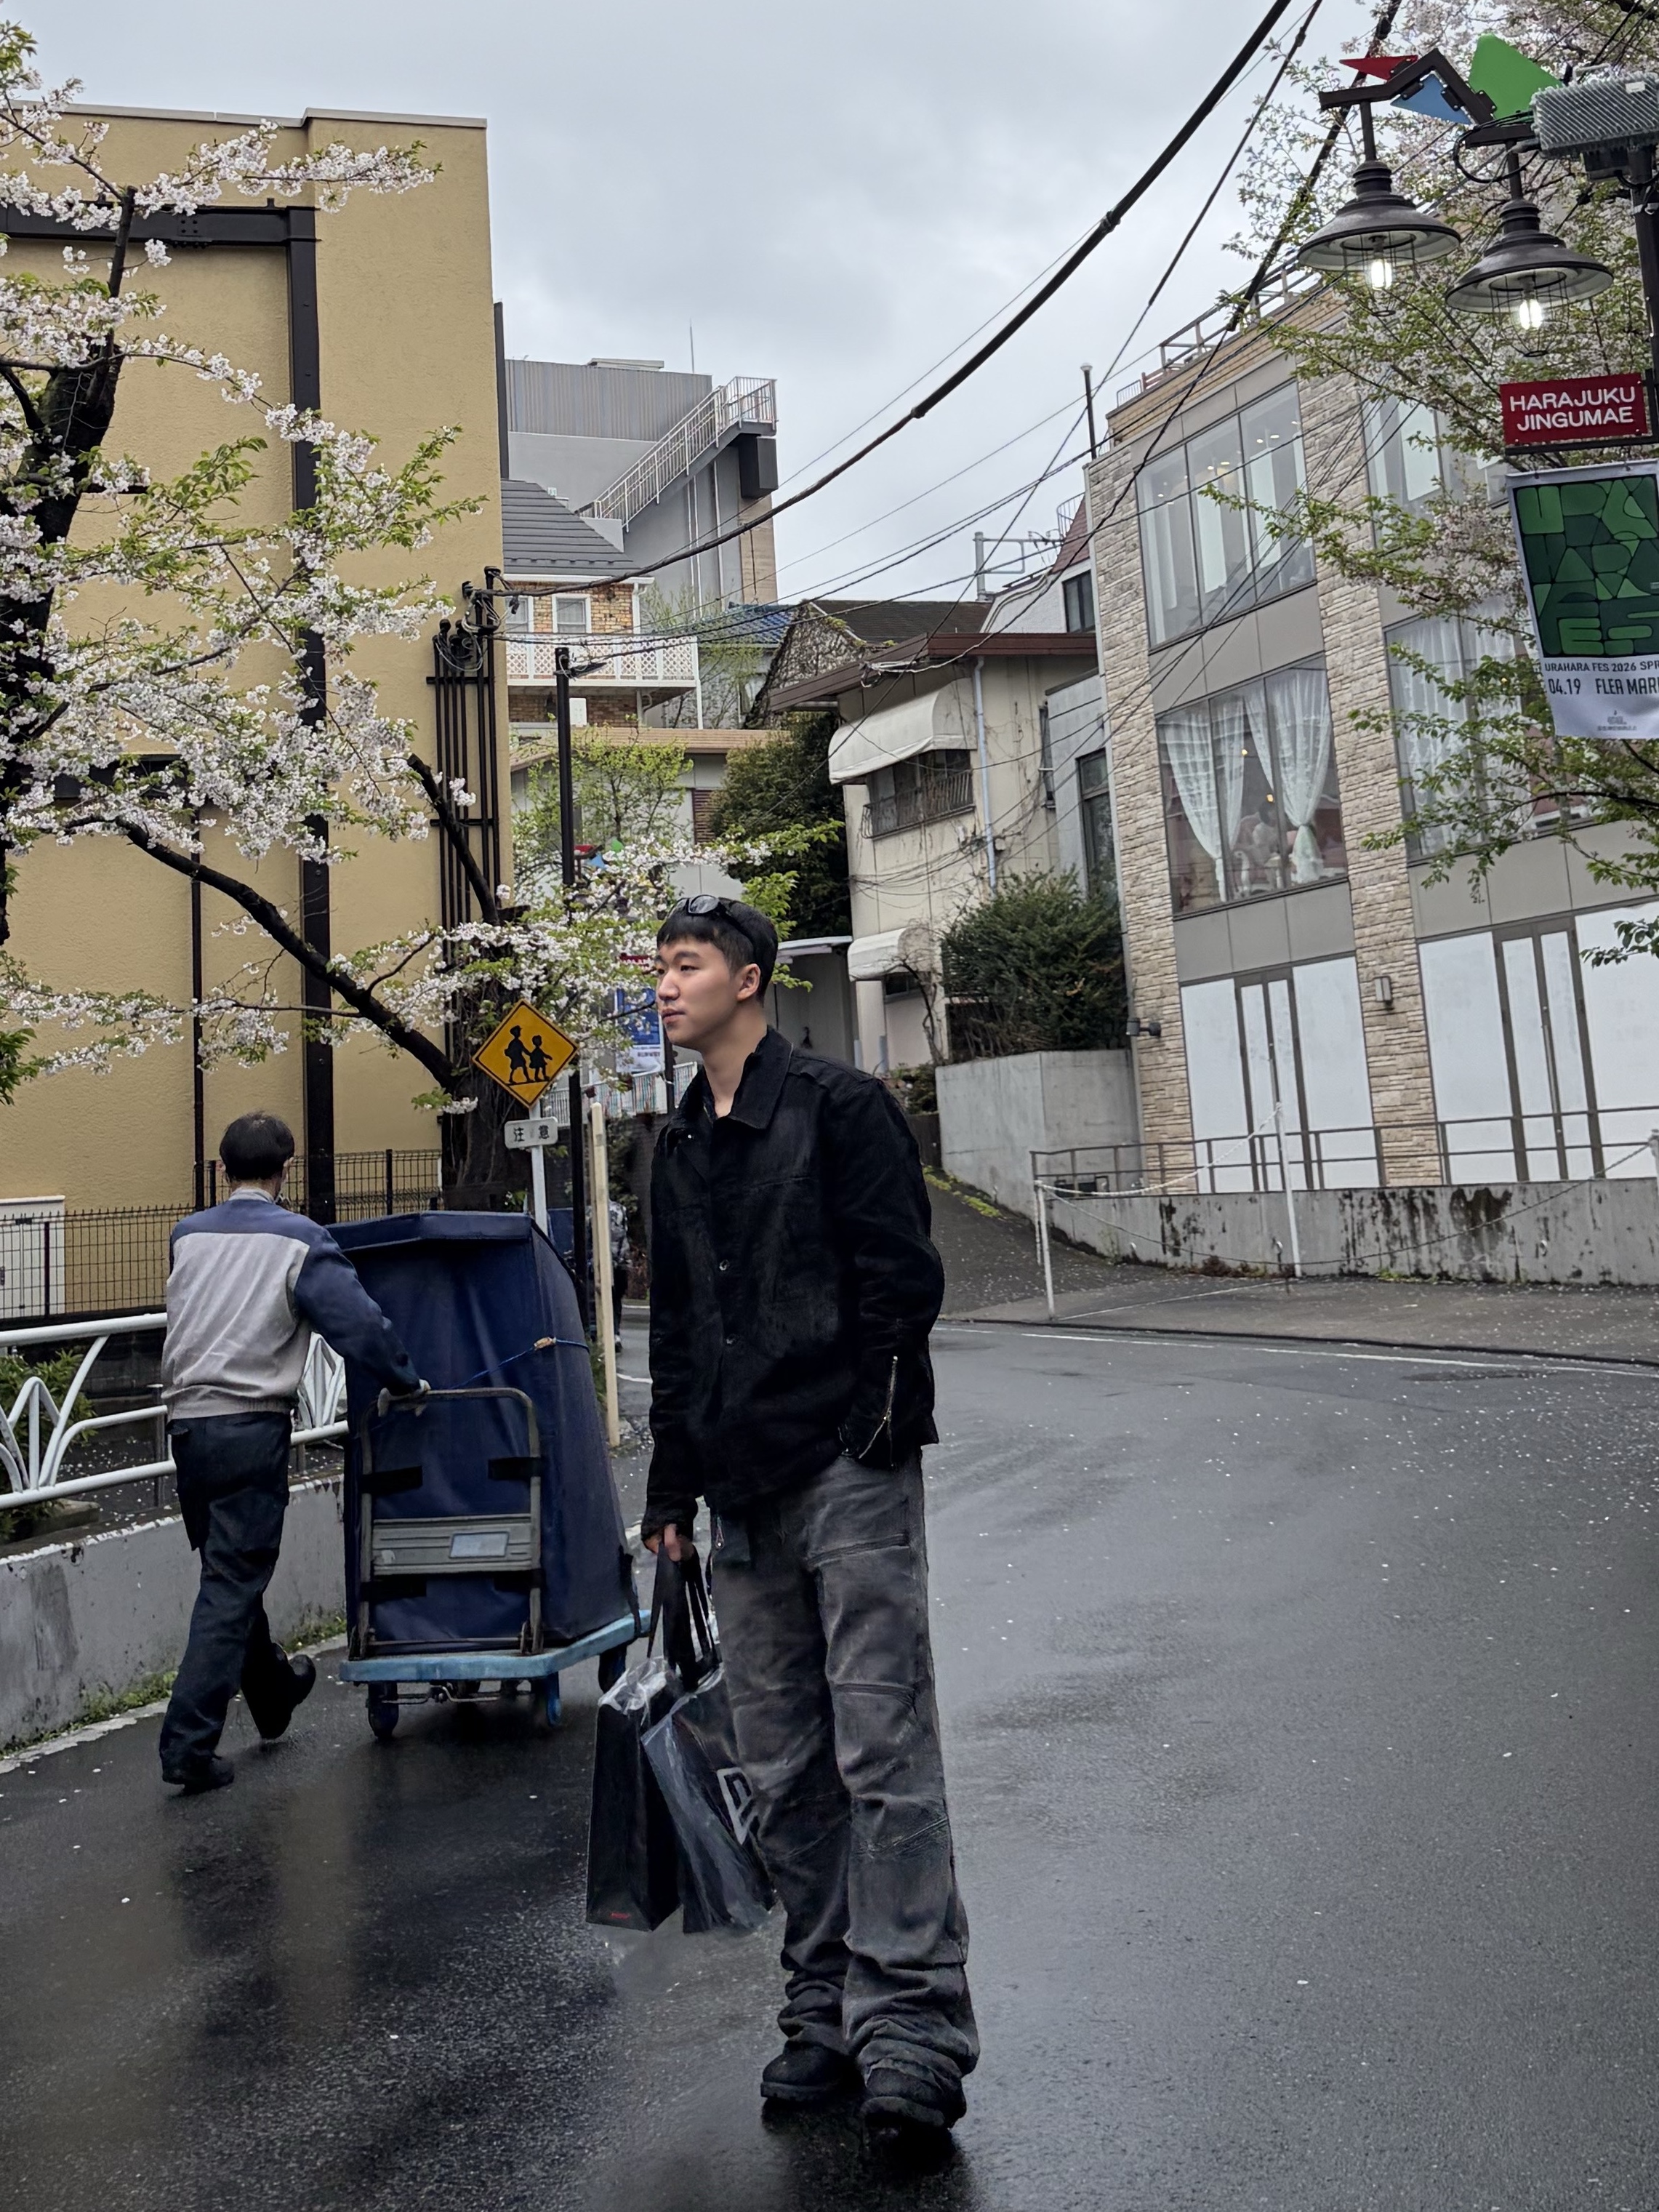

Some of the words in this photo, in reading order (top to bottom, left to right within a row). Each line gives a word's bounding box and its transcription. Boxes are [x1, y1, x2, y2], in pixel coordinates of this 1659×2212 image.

[1510, 386, 1636, 412] HARAJUKU
[1517, 406, 1634, 431] JINGUMAE
[1545, 662, 1590, 672] URAHARA
[1592, 662, 1610, 672] FES
[1611, 662, 1636, 672] 2026
[1548, 678, 1580, 694] 04.19
[1595, 678, 1624, 694] FLEA
[1626, 676, 1659, 694] MAR
[513, 1124, 550, 1142] 注意
